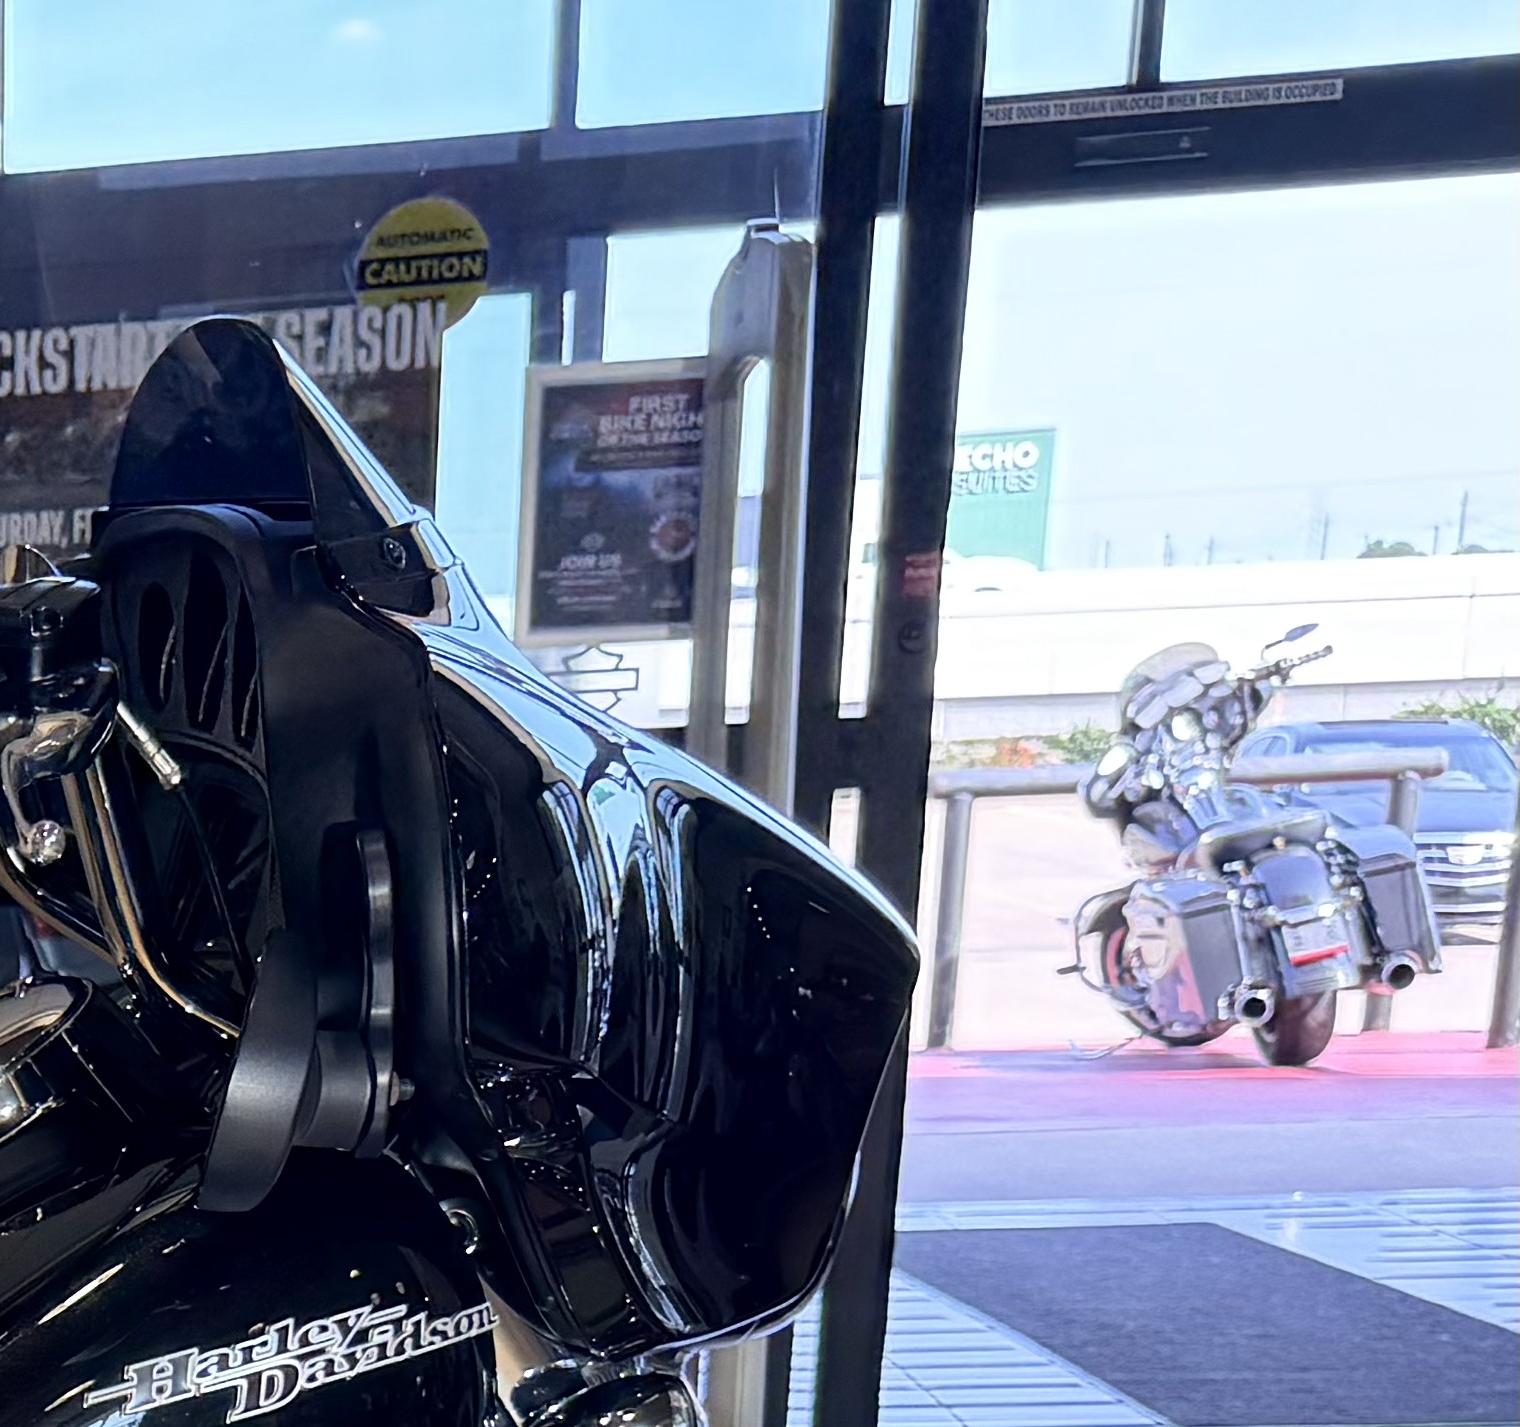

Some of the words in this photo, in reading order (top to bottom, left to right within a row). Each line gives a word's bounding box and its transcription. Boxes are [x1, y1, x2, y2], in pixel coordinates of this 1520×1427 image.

[1015, 104, 1050, 120] DOORS
[1053, 102, 1067, 116] TO
[1068, 99, 1107, 116] REMAIN
[1110, 95, 1165, 113] UNLOCKED
[1166, 92, 1198, 108] WHEN
[1199, 91, 1219, 105] THE
[1221, 87, 1270, 104] BUILDING
[1272, 85, 1283, 100] IS
[377, 227, 475, 248] AUTOMATIC
[364, 254, 484, 286] CAUTION
[272, 300, 448, 376] SEASON
[628, 394, 690, 413] FIRST
[650, 411, 704, 431] NIGH
[652, 429, 704, 445] SEASO
[952, 440, 1040, 473] ECHO
[951, 470, 1039, 496] SUITES
[199, 1301, 500, 1425] Davidson
